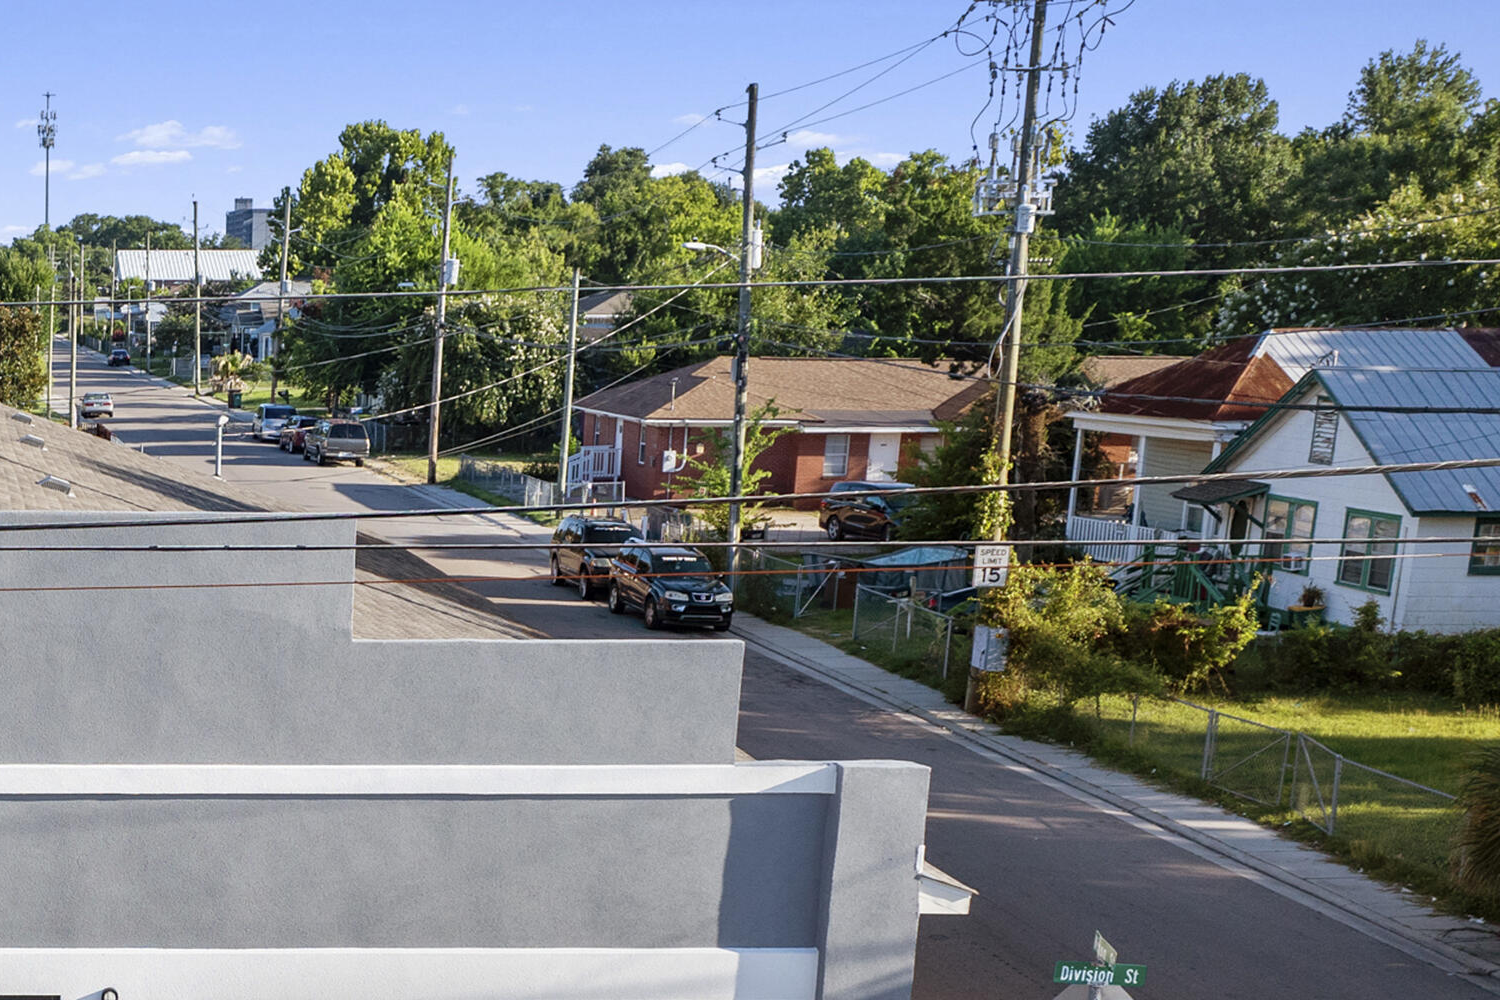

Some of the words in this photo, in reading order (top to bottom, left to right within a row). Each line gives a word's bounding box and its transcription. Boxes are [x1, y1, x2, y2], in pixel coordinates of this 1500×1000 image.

[980, 548, 1007, 556] SPEED
[982, 568, 1000, 582] 15
[1060, 965, 1114, 983] Division
[1124, 968, 1139, 984] St
